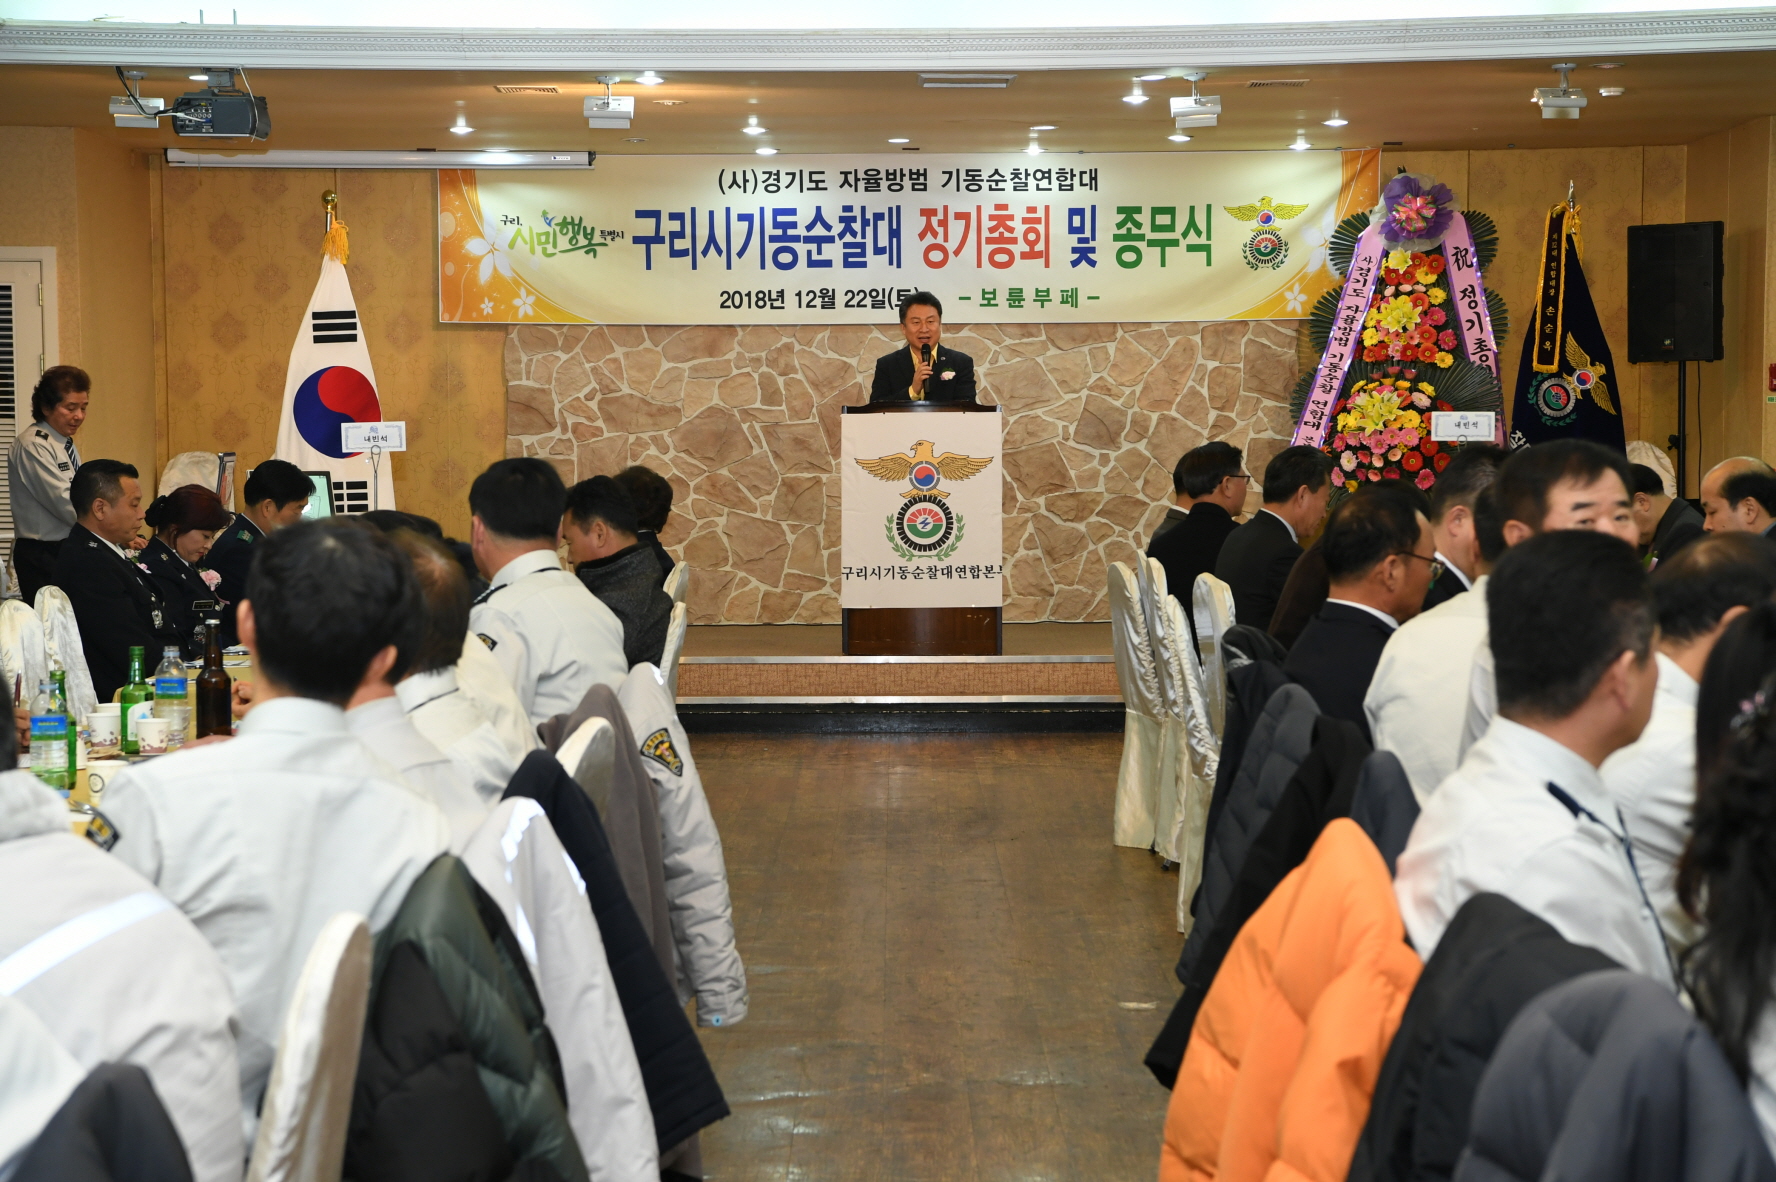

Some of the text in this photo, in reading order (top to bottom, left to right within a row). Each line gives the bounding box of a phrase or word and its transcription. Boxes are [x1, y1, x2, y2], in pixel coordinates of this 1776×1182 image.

[718, 167, 1099, 195] (사)경기도 자율방범 기동순찰연합대
[599, 229, 625, 242] 특별시
[632, 203, 1213, 271] 구리시기동순찰대 정기총회 및 종무식
[1452, 246, 1474, 272] 祝
[1346, 253, 1378, 299] (사)경기도
[719, 288, 785, 310] 2018년
[794, 288, 836, 310] 12월
[844, 287, 919, 310] 22일(토
[1334, 304, 1363, 347] 자율방범
[1316, 352, 1345, 395] 기동순찰
[1303, 400, 1328, 431] 연합대
[1454, 420, 1479, 430] 내빈석
[363, 435, 388, 443] 내빈석
